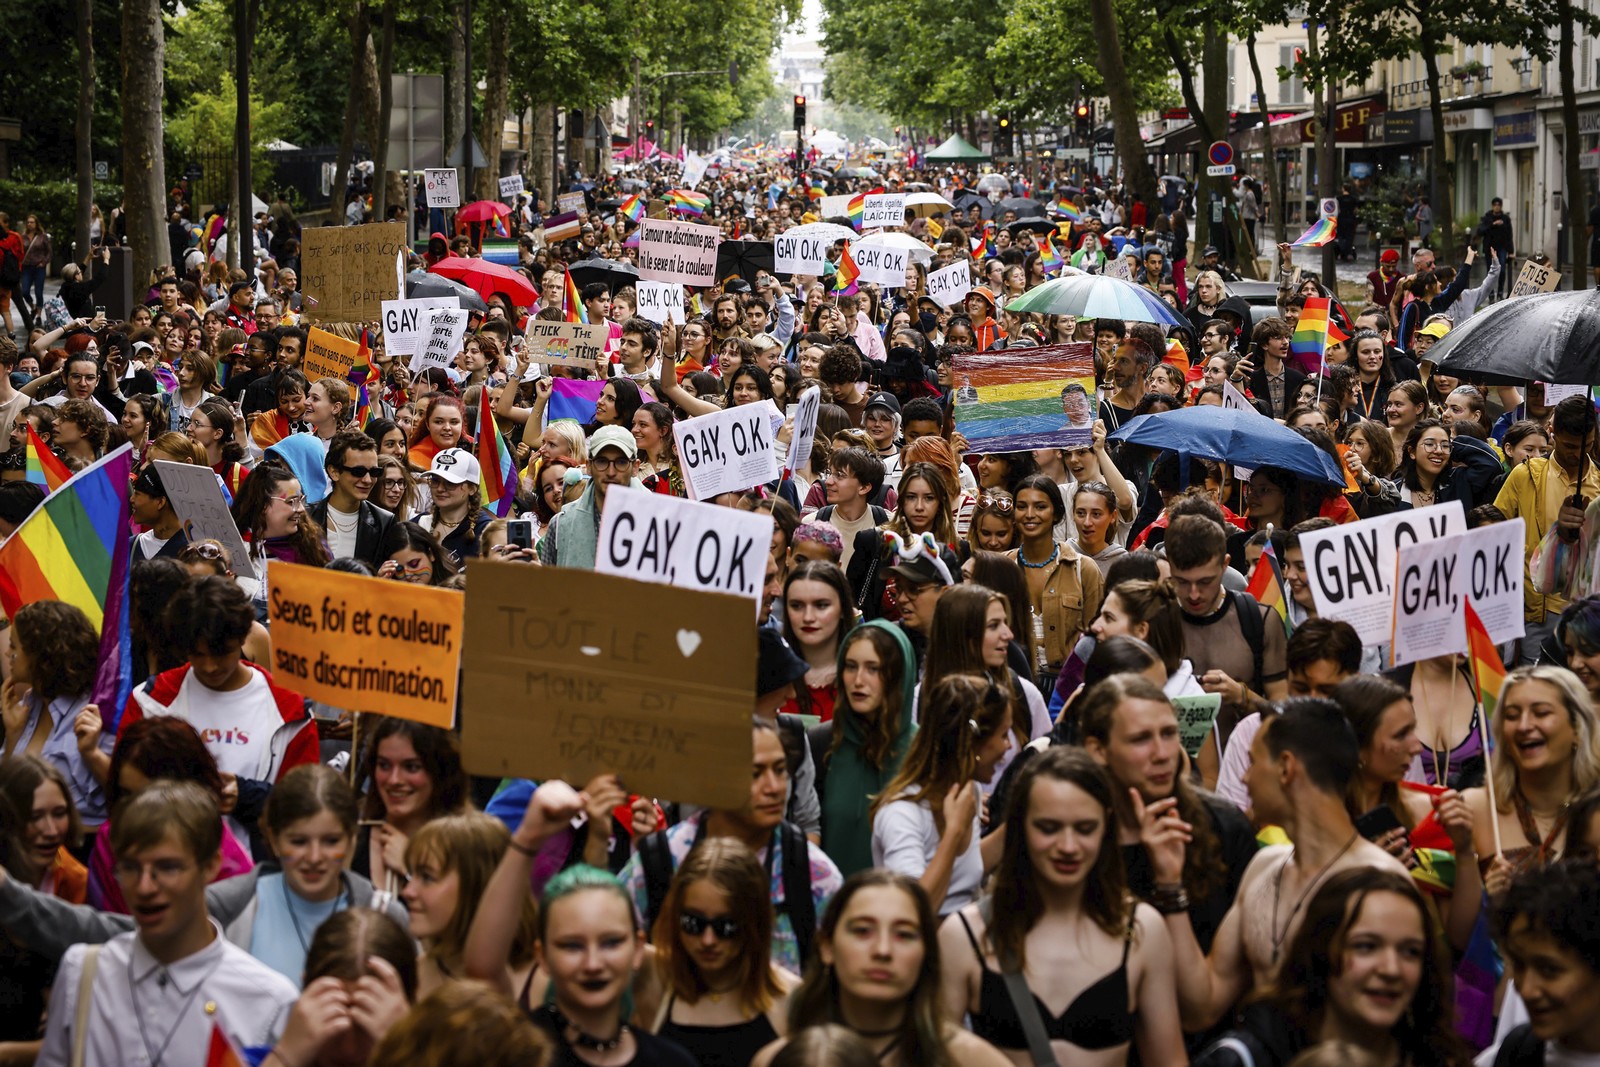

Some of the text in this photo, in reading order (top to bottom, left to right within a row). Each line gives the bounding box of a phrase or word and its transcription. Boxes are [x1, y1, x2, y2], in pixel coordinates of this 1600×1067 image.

[864, 209, 903, 221] LAÏCITÉ!
[641, 223, 716, 253] L'amour ne discrimine pas,
[801, 240, 822, 261] O.K.
[857, 249, 904, 271] GAY, O.K.
[640, 251, 714, 276] ni le sexe ni la couleur.
[306, 273, 326, 288] MOI
[930, 267, 969, 295] GAY, O.K.
[1534, 269, 1549, 285] ES
[638, 288, 682, 309] GAY, O.K.
[533, 325, 561, 337] FUCK
[309, 340, 326, 357] L'amour
[327, 349, 339, 362] sans
[307, 360, 320, 374] moins
[321, 364, 326, 377] de
[683, 425, 727, 468] GAY,
[731, 417, 769, 457] O.K.
[610, 512, 754, 593] GAY, O.K.
[1314, 529, 1391, 604] GAY,
[1402, 543, 1517, 615] GAY, O.K.
[272, 587, 452, 653] Sexe, foi et couleur,
[276, 648, 448, 704] sans discrimination.
[200, 726, 250, 745] evi's
